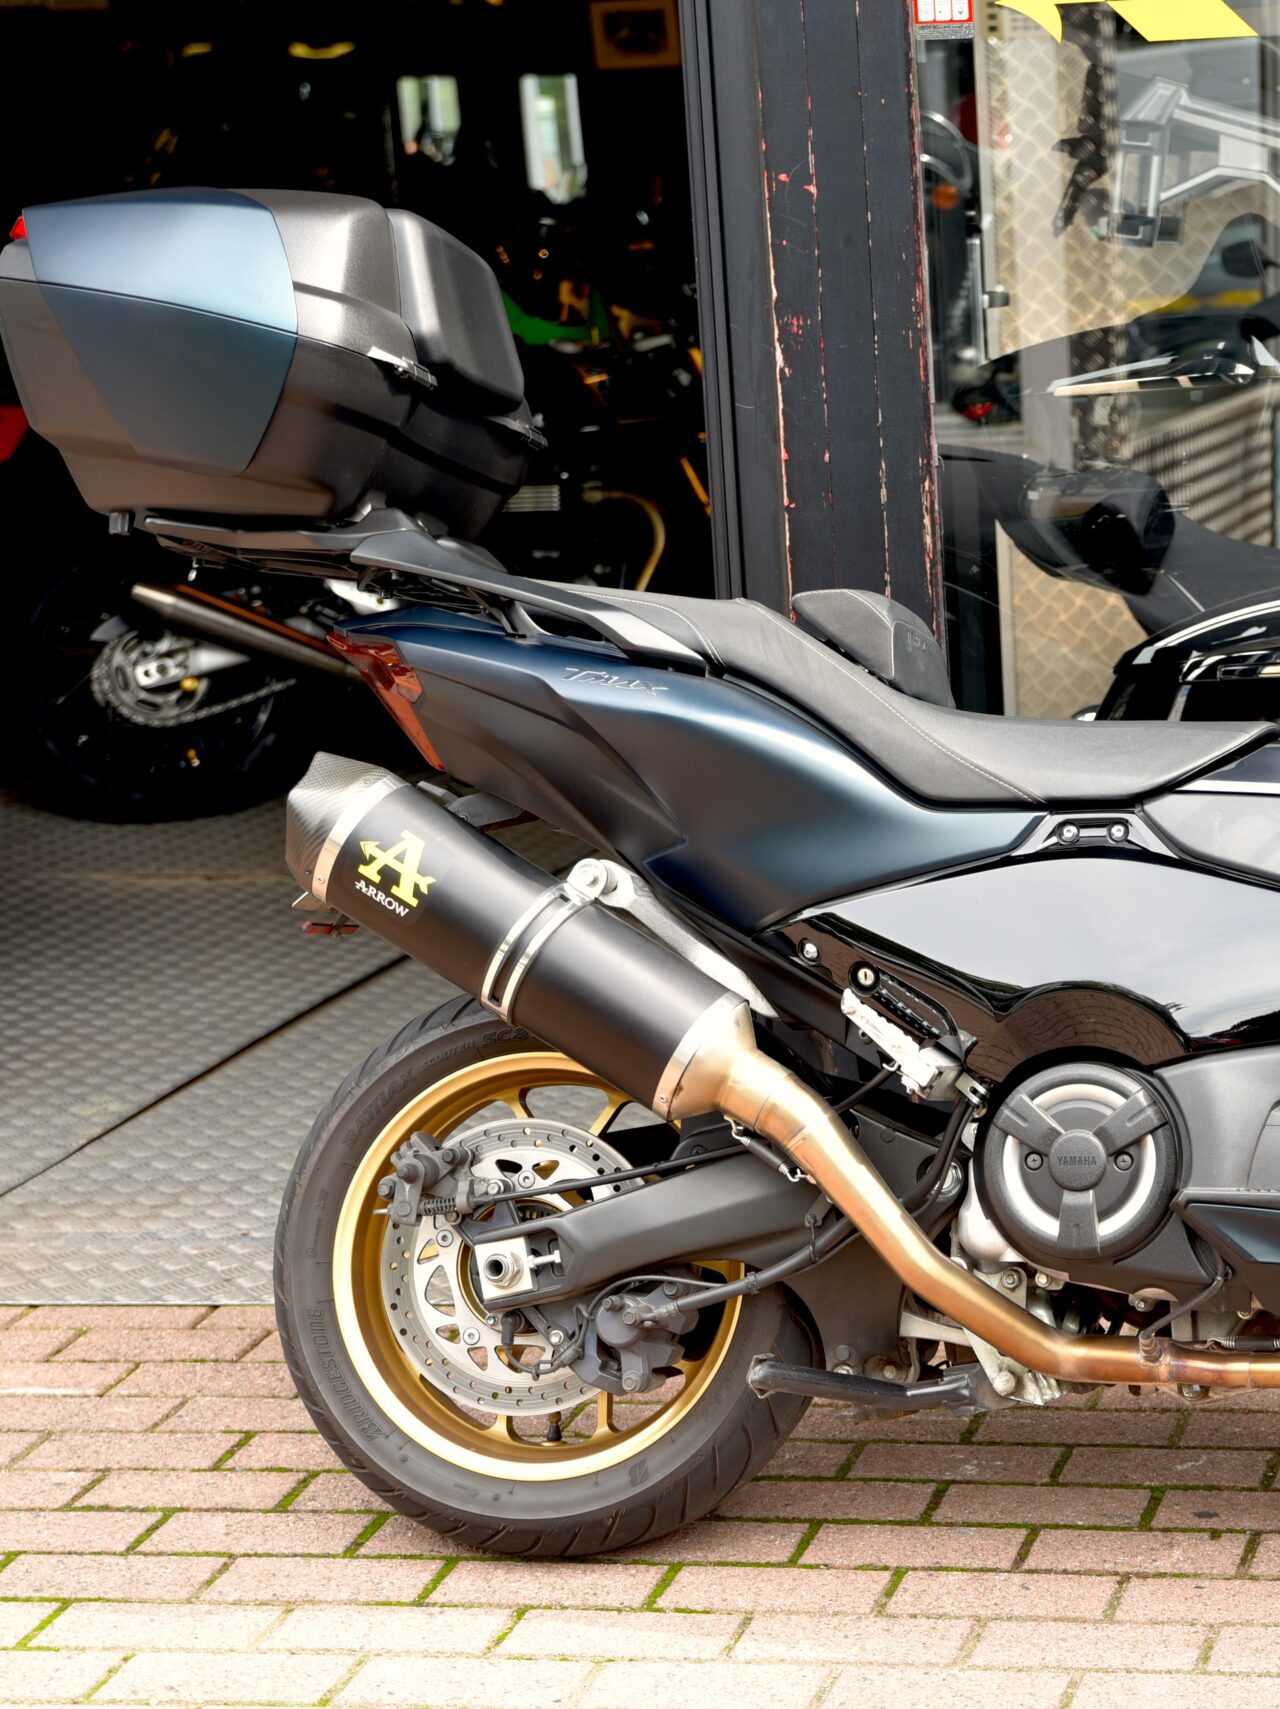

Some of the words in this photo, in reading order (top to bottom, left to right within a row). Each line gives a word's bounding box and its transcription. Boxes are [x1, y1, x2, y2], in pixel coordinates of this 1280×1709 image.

[354, 879, 410, 917] ARROW
[1057, 1155, 1098, 1167] YAMAHA
[306, 1307, 386, 1442] BRIDGESTONE
